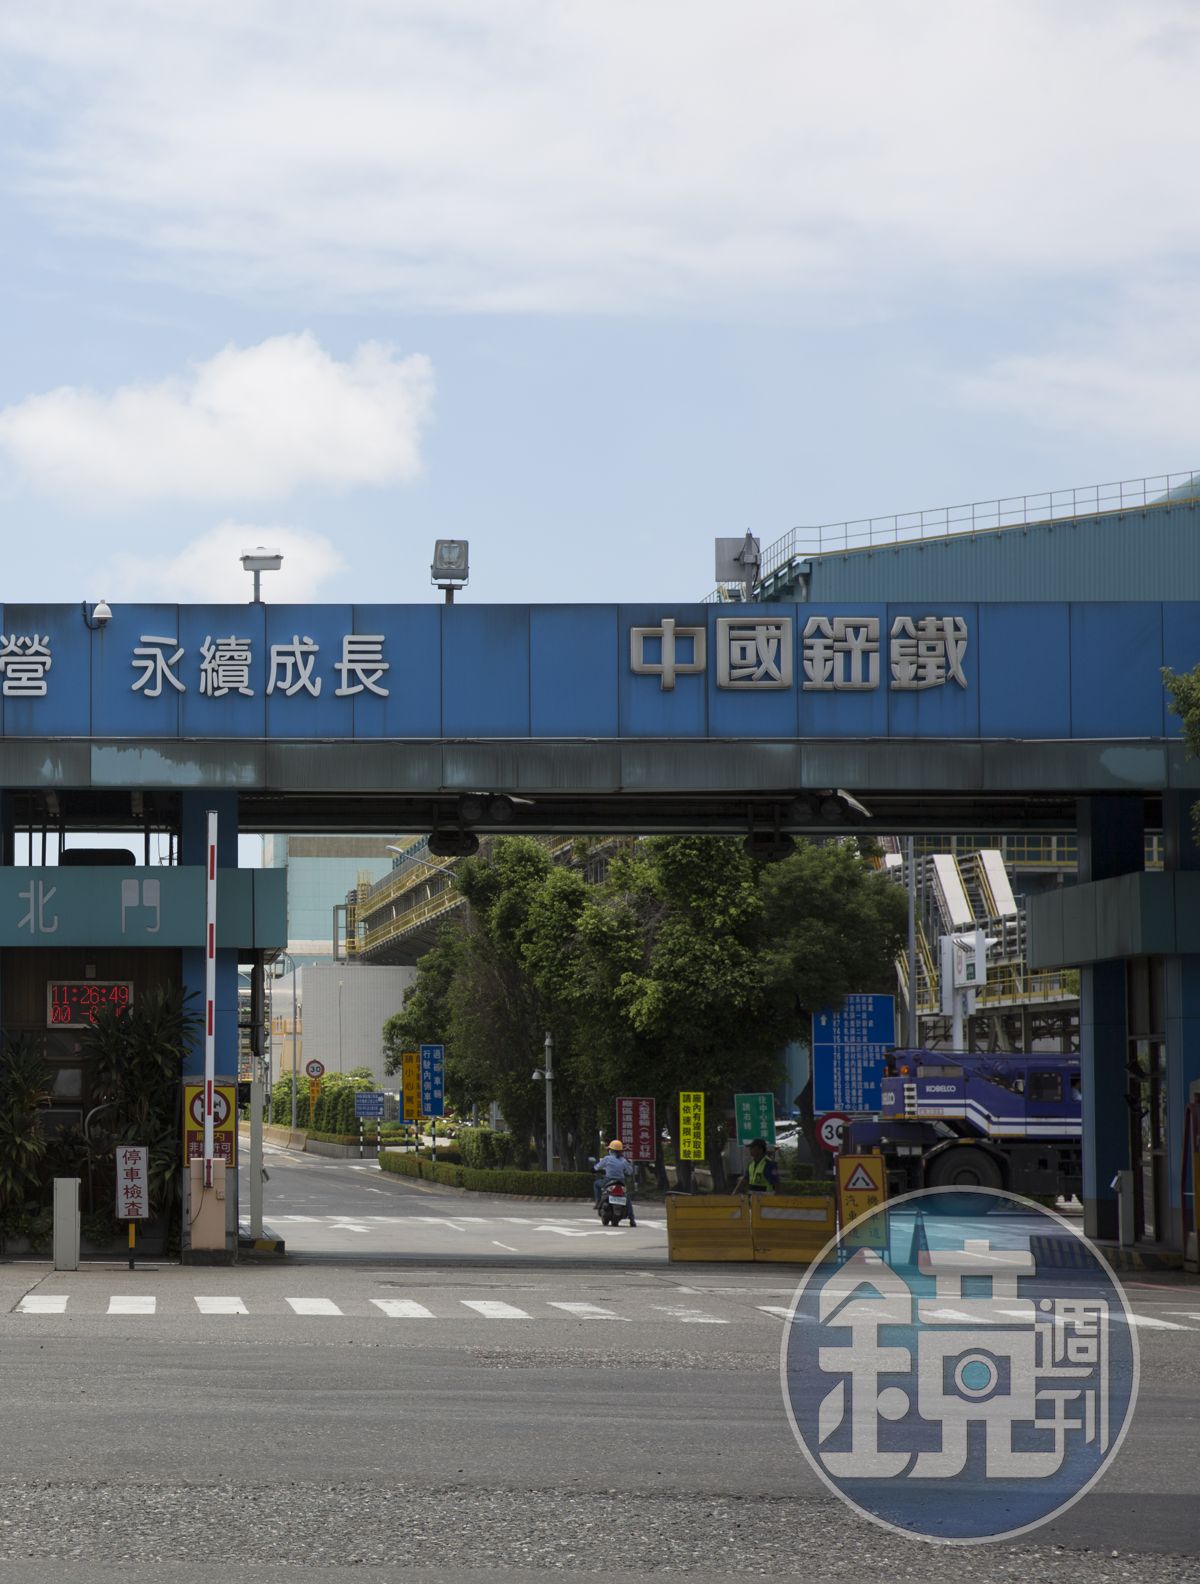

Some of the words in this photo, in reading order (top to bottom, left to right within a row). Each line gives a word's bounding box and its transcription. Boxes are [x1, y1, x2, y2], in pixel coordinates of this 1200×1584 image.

[131, 634, 390, 697] 永續成長
[630, 616, 969, 691] 中國鋼鐵
[17, 879, 161, 934] 北門
[51, 984, 130, 1005] 11:26:49
[122, 1149, 143, 1217] 停車檢查
